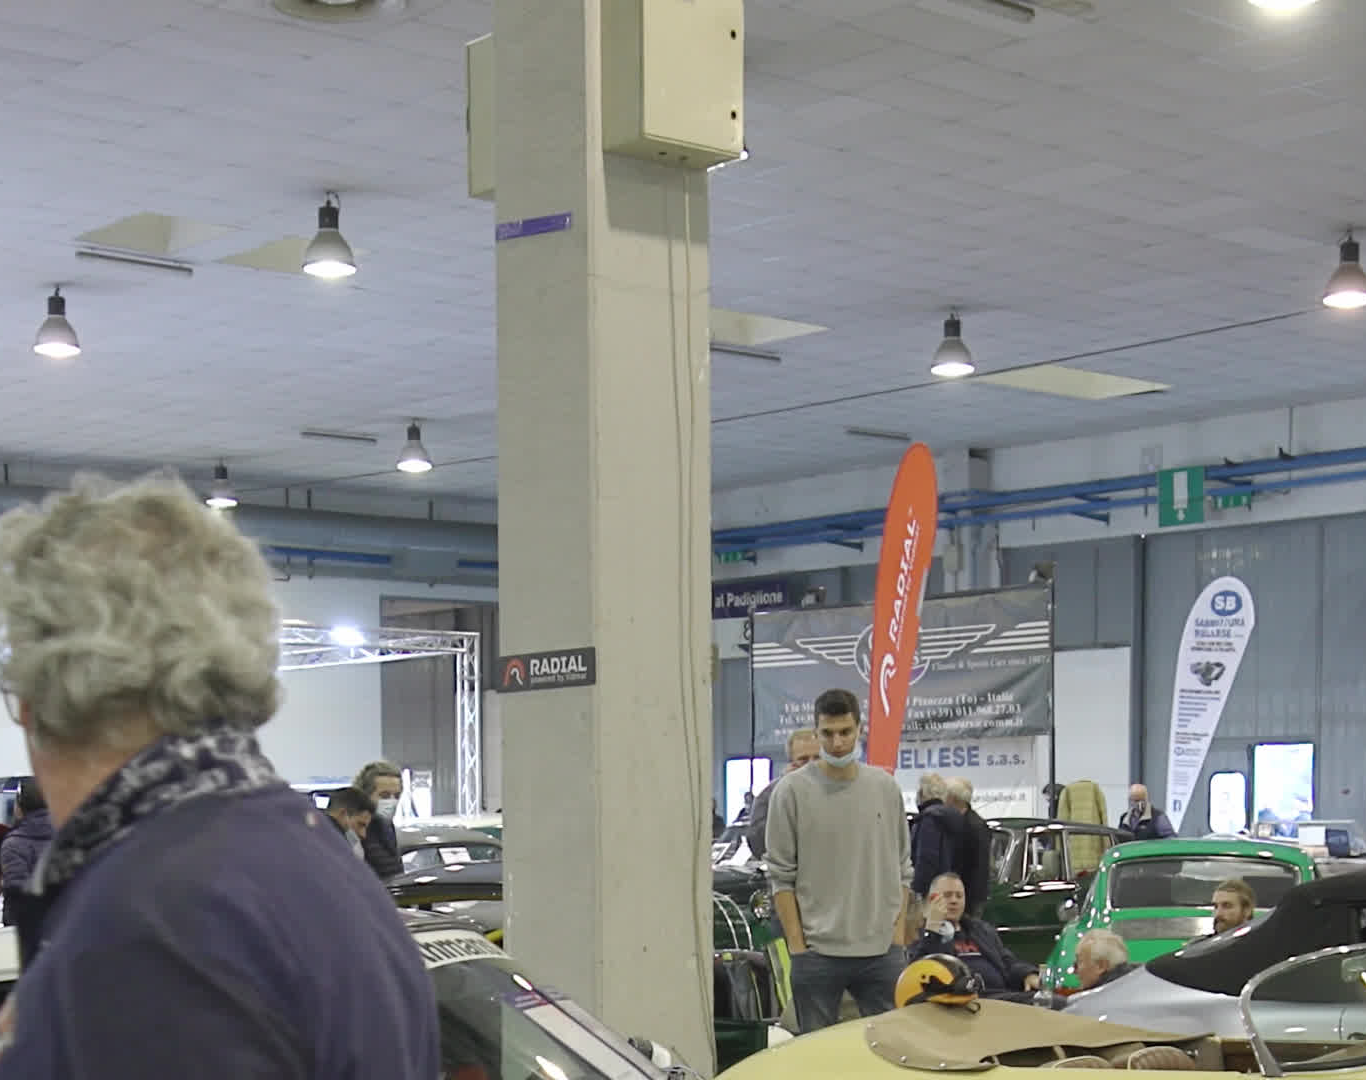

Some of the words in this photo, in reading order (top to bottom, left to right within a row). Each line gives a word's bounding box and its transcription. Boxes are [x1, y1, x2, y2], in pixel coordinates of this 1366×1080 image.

[889, 519, 917, 643] RADIAL
[727, 591, 784, 609] Padiglione
[530, 655, 587, 676] RADIAL
